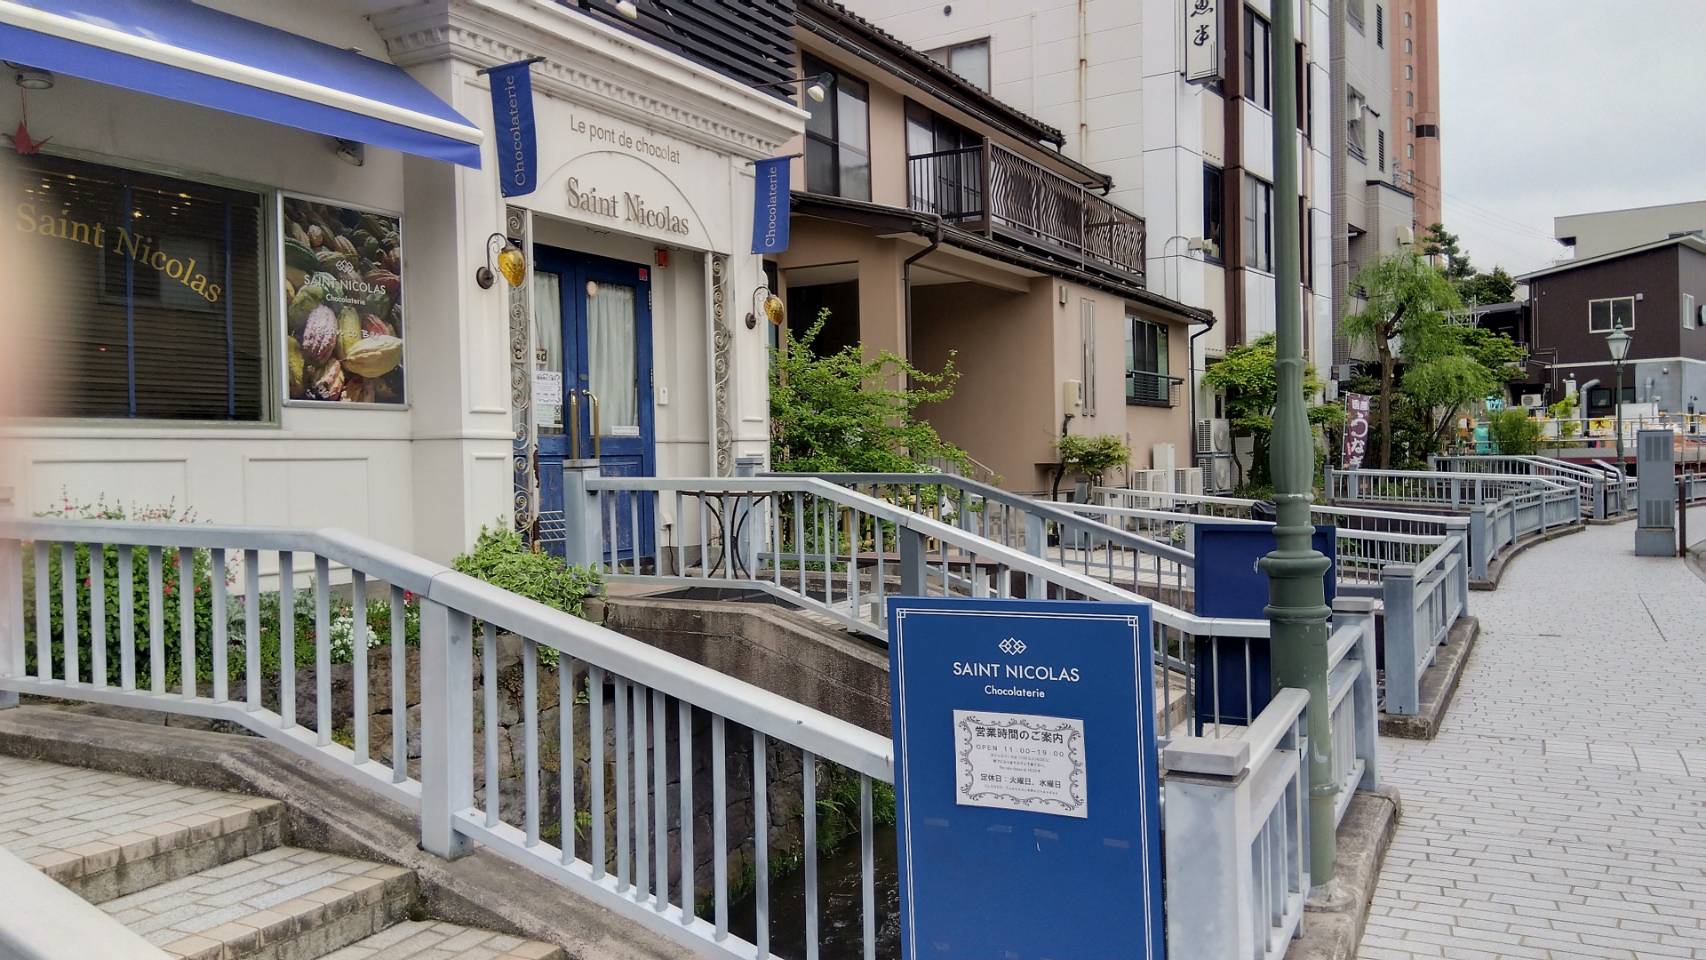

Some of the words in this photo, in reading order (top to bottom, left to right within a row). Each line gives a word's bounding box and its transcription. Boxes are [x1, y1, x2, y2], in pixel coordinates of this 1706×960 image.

[504, 75, 527, 186] Chocolaterie
[570, 114, 586, 134] Le
[589, 124, 616, 142] pont
[618, 131, 633, 149] de
[635, 137, 681, 165] chocolat
[567, 176, 620, 219] Saint
[624, 191, 690, 236] Nicolas
[765, 166, 778, 248] Chocolaterie
[16, 203, 105, 248] Saint
[113, 226, 223, 303] Nicolas
[304, 274, 337, 291] SAINT
[340, 279, 387, 296] NICOLAS
[325, 293, 366, 306] Chocolaterie
[952, 661, 1001, 678] SAINT
[1005, 664, 1080, 682] NICOLAS
[984, 685, 1045, 698] Chocolaterie
[974, 726, 1064, 744] 営業時間のご案内
